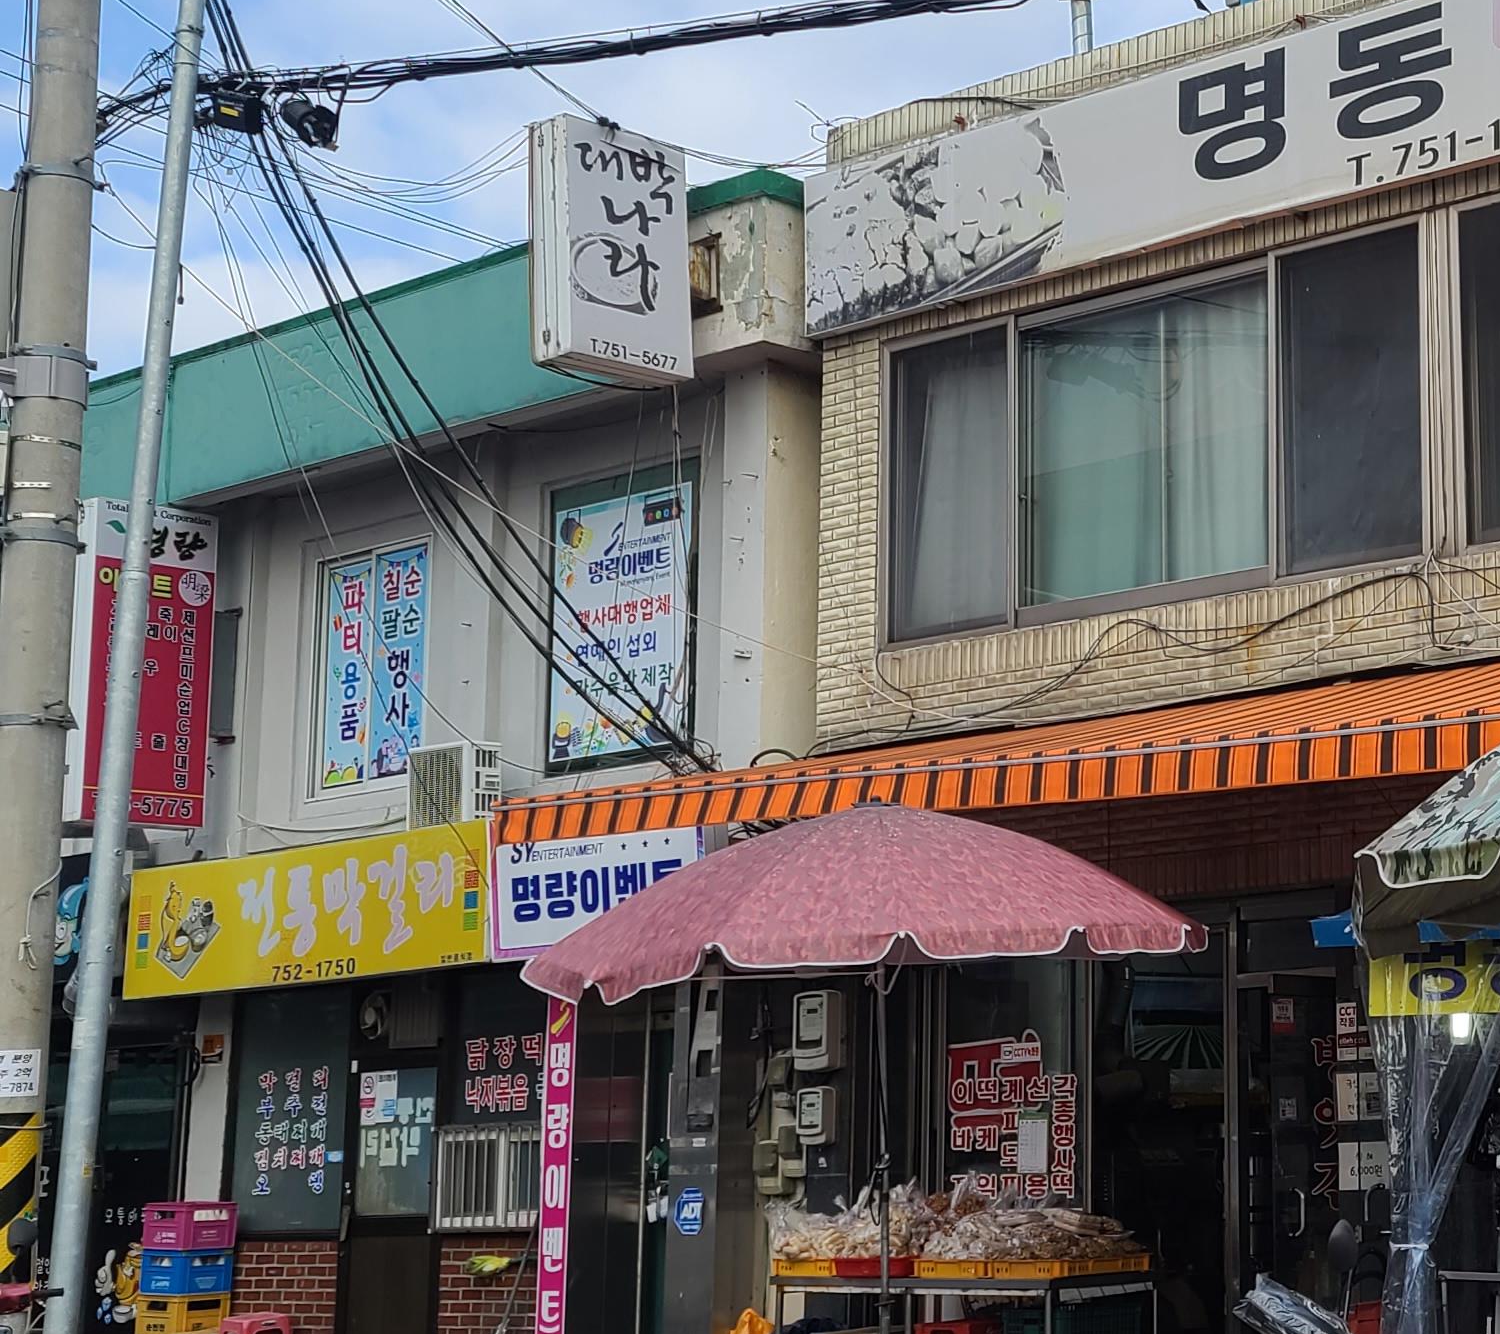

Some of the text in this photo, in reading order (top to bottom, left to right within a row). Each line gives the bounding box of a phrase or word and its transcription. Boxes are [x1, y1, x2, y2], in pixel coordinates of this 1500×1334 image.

[590, 338, 678, 371] T.751-5677
[106, 500, 212, 527] Total Corporation
[99, 567, 173, 599] 이트
[383, 565, 423, 602] 칠순
[381, 603, 421, 641] 팔순
[578, 593, 672, 634] 행사대행업체
[626, 630, 657, 658] 섭외
[339, 579, 365, 742] 파티용품
[641, 662, 674, 688] 제작
[385, 648, 410, 727] 행사
[91, 791, 193, 818] -5775
[532, 842, 605, 862] ENTERTAINMENT
[238, 844, 455, 958] 전통막걸리
[272, 957, 357, 983] 752-1750
[0, 1081, 34, 1094] -7874
[256, 1092, 328, 1120] 부추전
[1052, 1074, 1077, 1199] 각종행사떡
[539, 1042, 571, 1334] 명량이벤트
[680, 1202, 703, 1220] ADT
